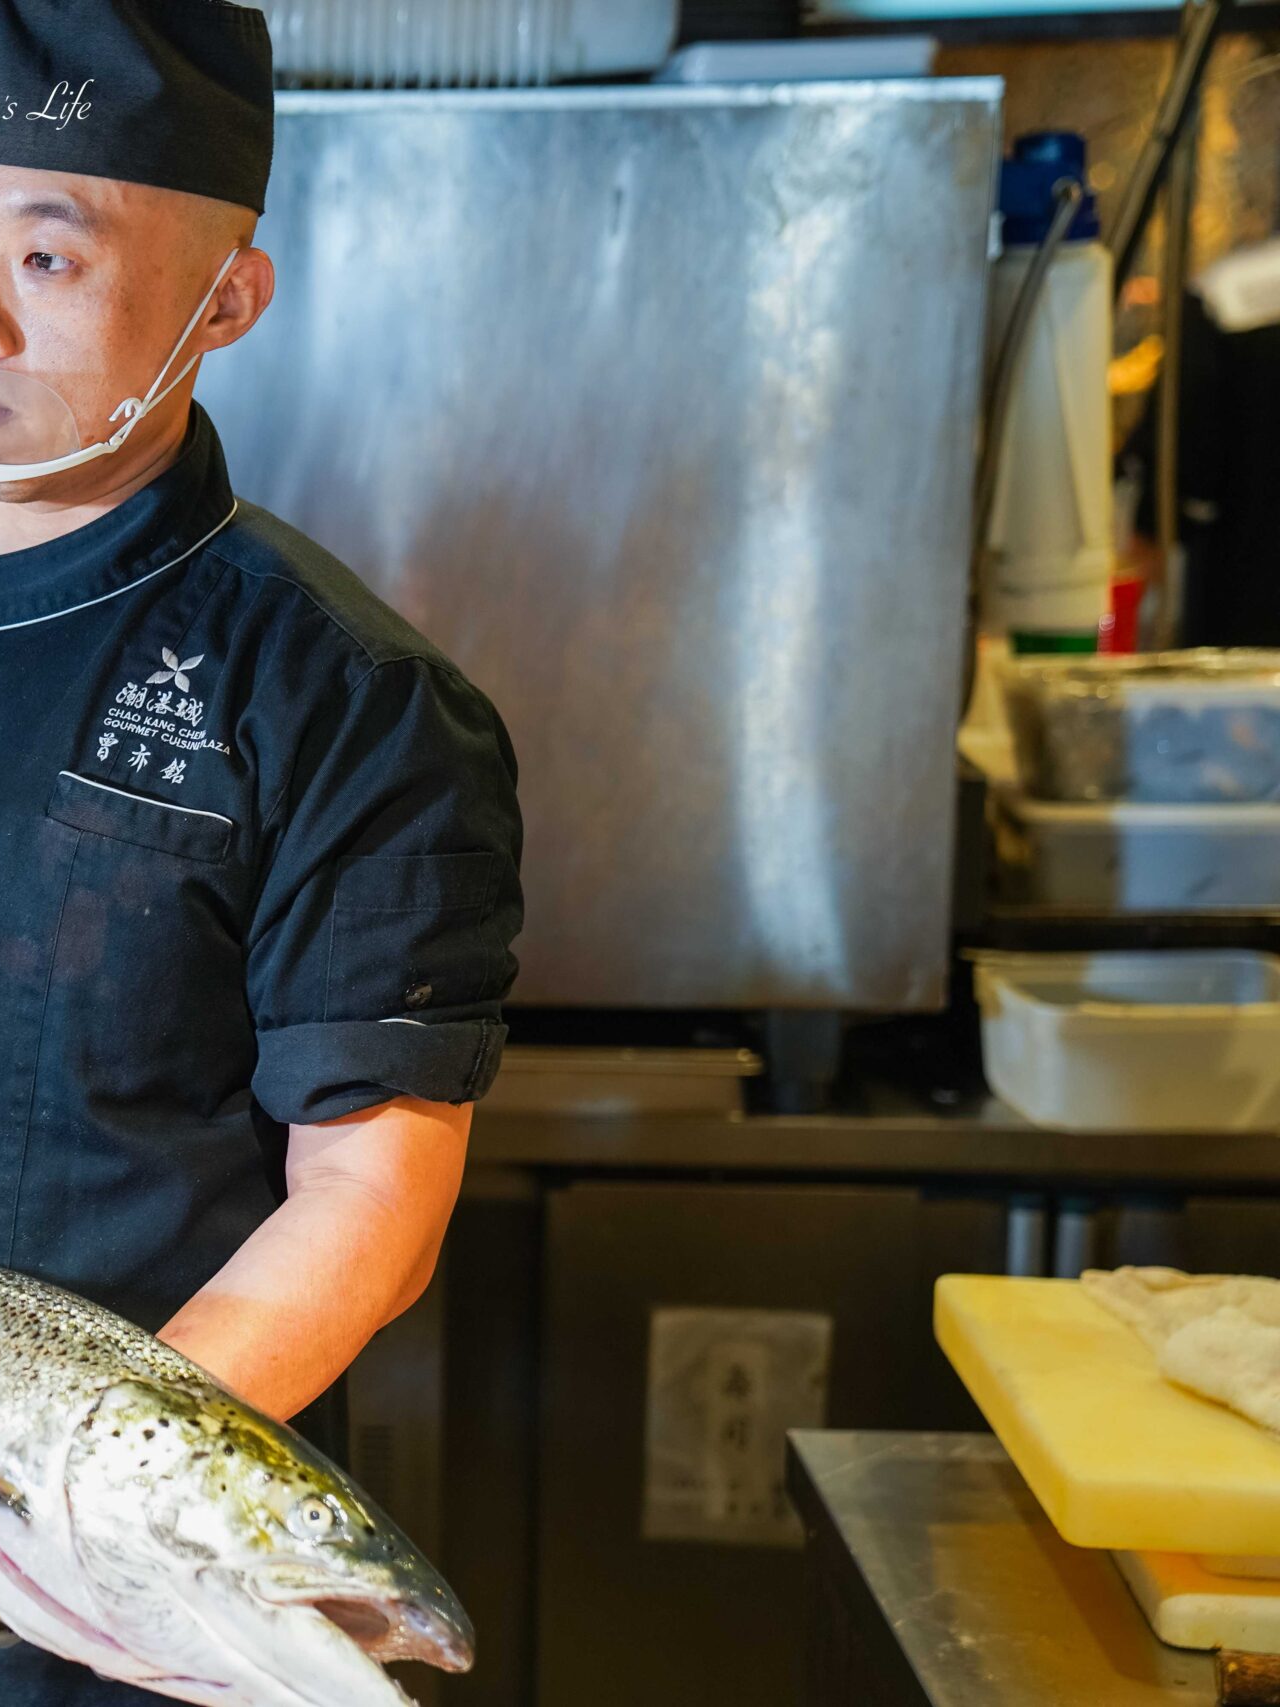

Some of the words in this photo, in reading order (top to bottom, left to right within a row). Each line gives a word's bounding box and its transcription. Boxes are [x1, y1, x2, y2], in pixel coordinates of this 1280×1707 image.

[115, 681, 204, 728] 潮港城
[103, 717, 159, 738] GOURMET
[108, 707, 141, 722] CHAO
[144, 715, 176, 733] KANG
[178, 728, 207, 741] CHEN
